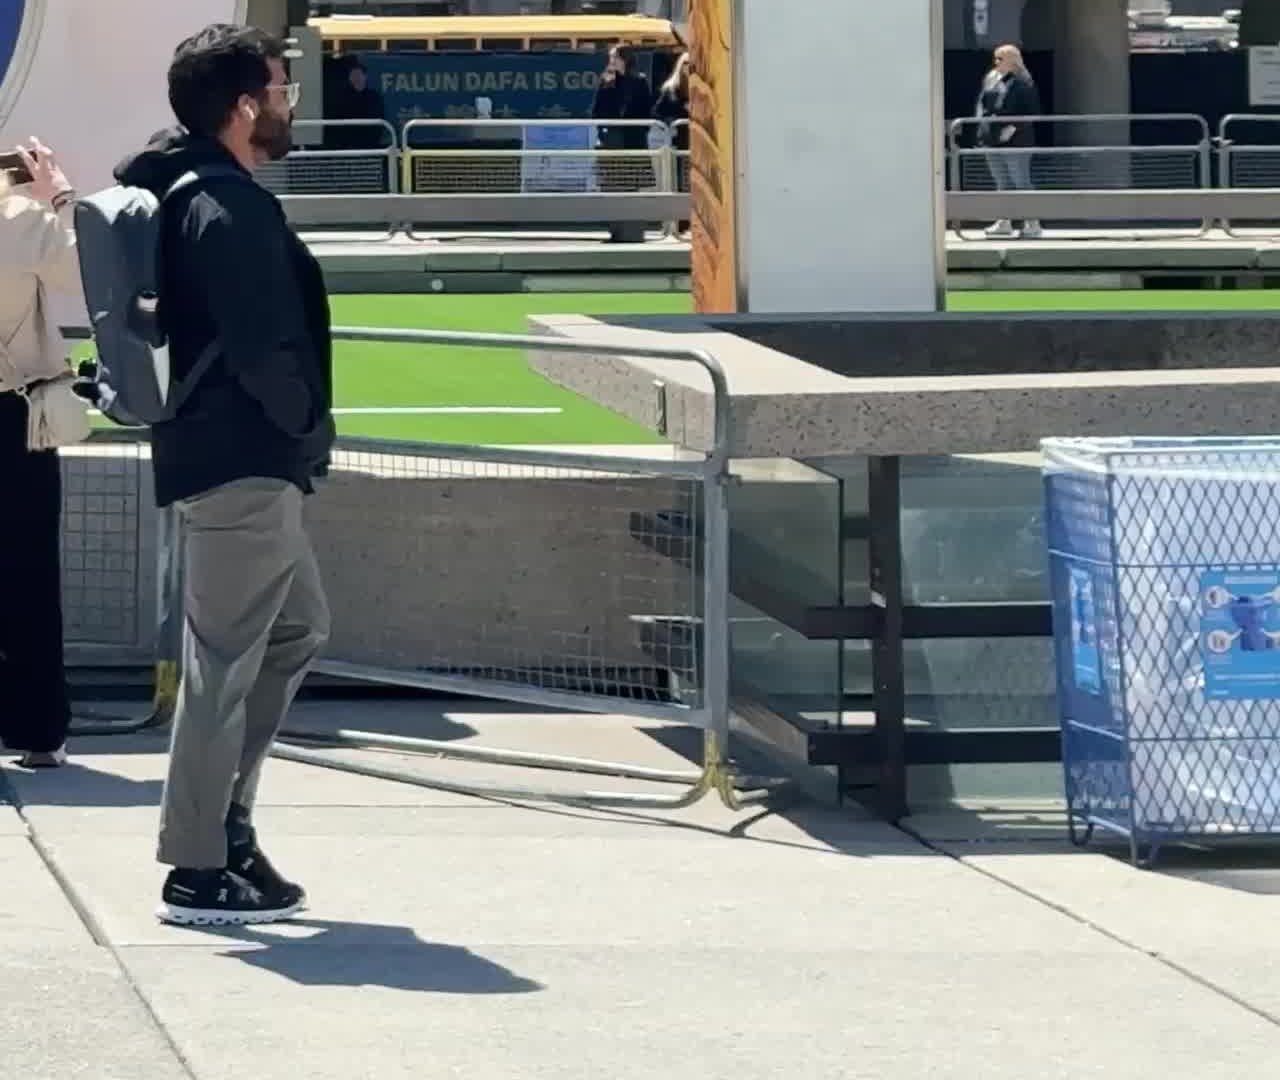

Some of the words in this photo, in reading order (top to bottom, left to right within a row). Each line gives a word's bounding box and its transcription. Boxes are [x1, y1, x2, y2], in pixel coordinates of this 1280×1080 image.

[380, 71, 459, 92] FALUN
[464, 71, 529, 92] DAFA
[535, 71, 560, 91] IS
[562, 71, 599, 91] GO
